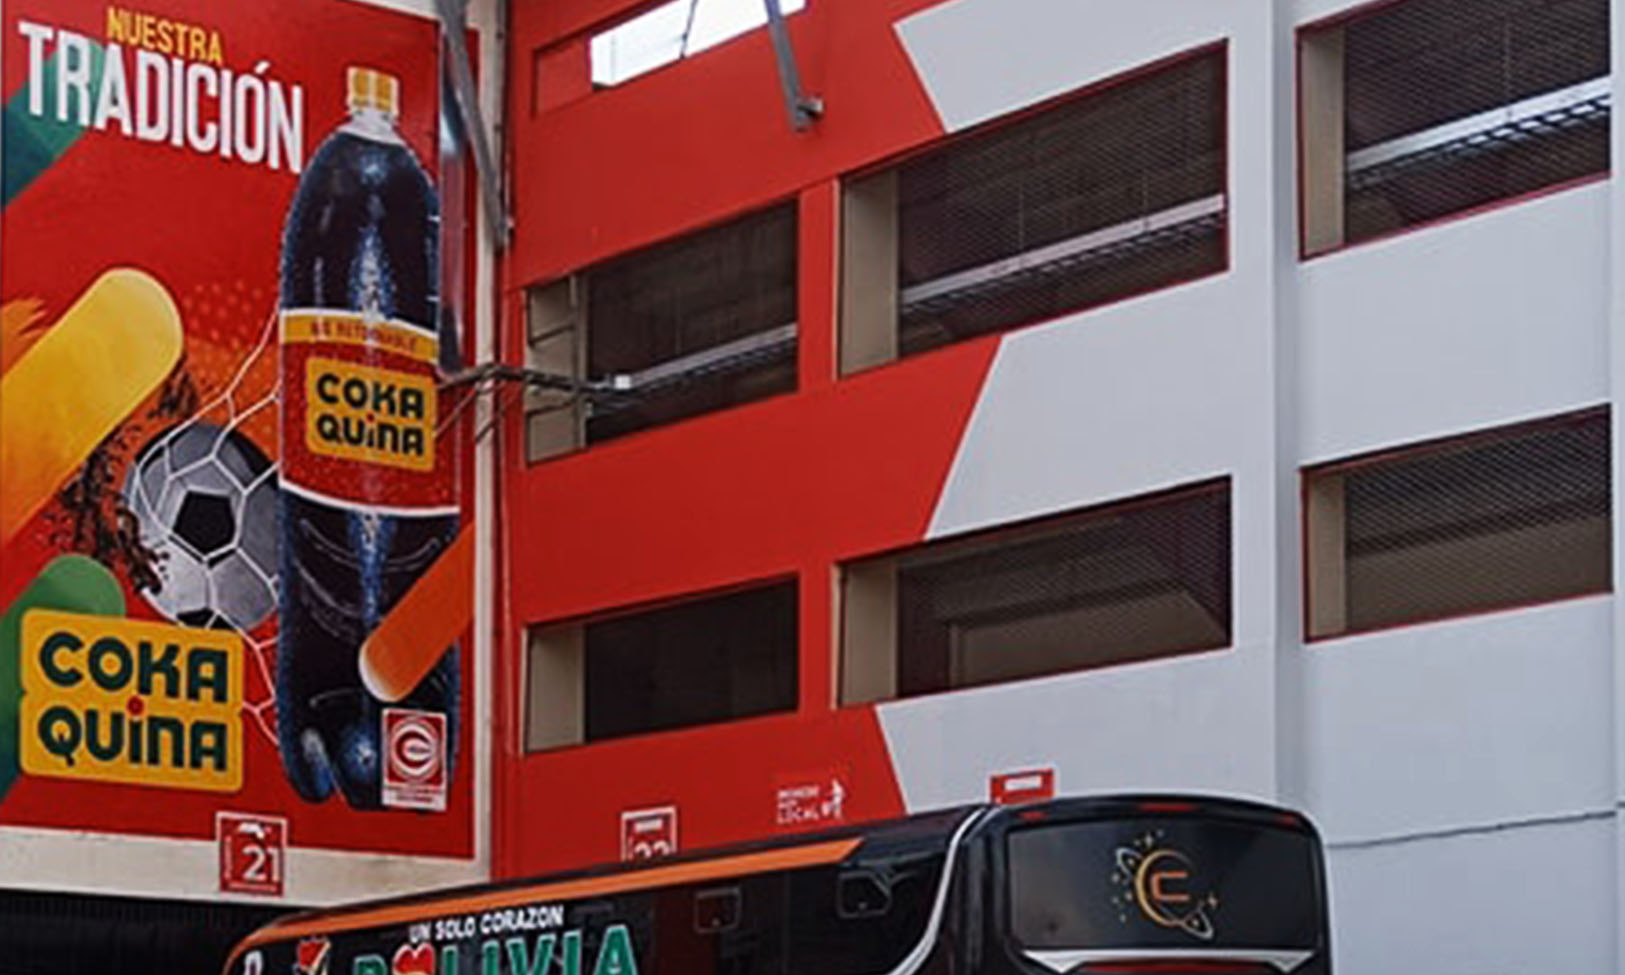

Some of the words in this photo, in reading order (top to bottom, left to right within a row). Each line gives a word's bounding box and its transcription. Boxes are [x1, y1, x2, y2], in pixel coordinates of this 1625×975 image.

[107, 7, 224, 66] NUESTRA
[18, 20, 304, 175] TRADICIÓN
[317, 373, 424, 419] COKA
[39, 631, 229, 703] COKA
[242, 845, 279, 882] 21
[436, 916, 475, 940] SOLO
[481, 904, 564, 934] CORAZON
